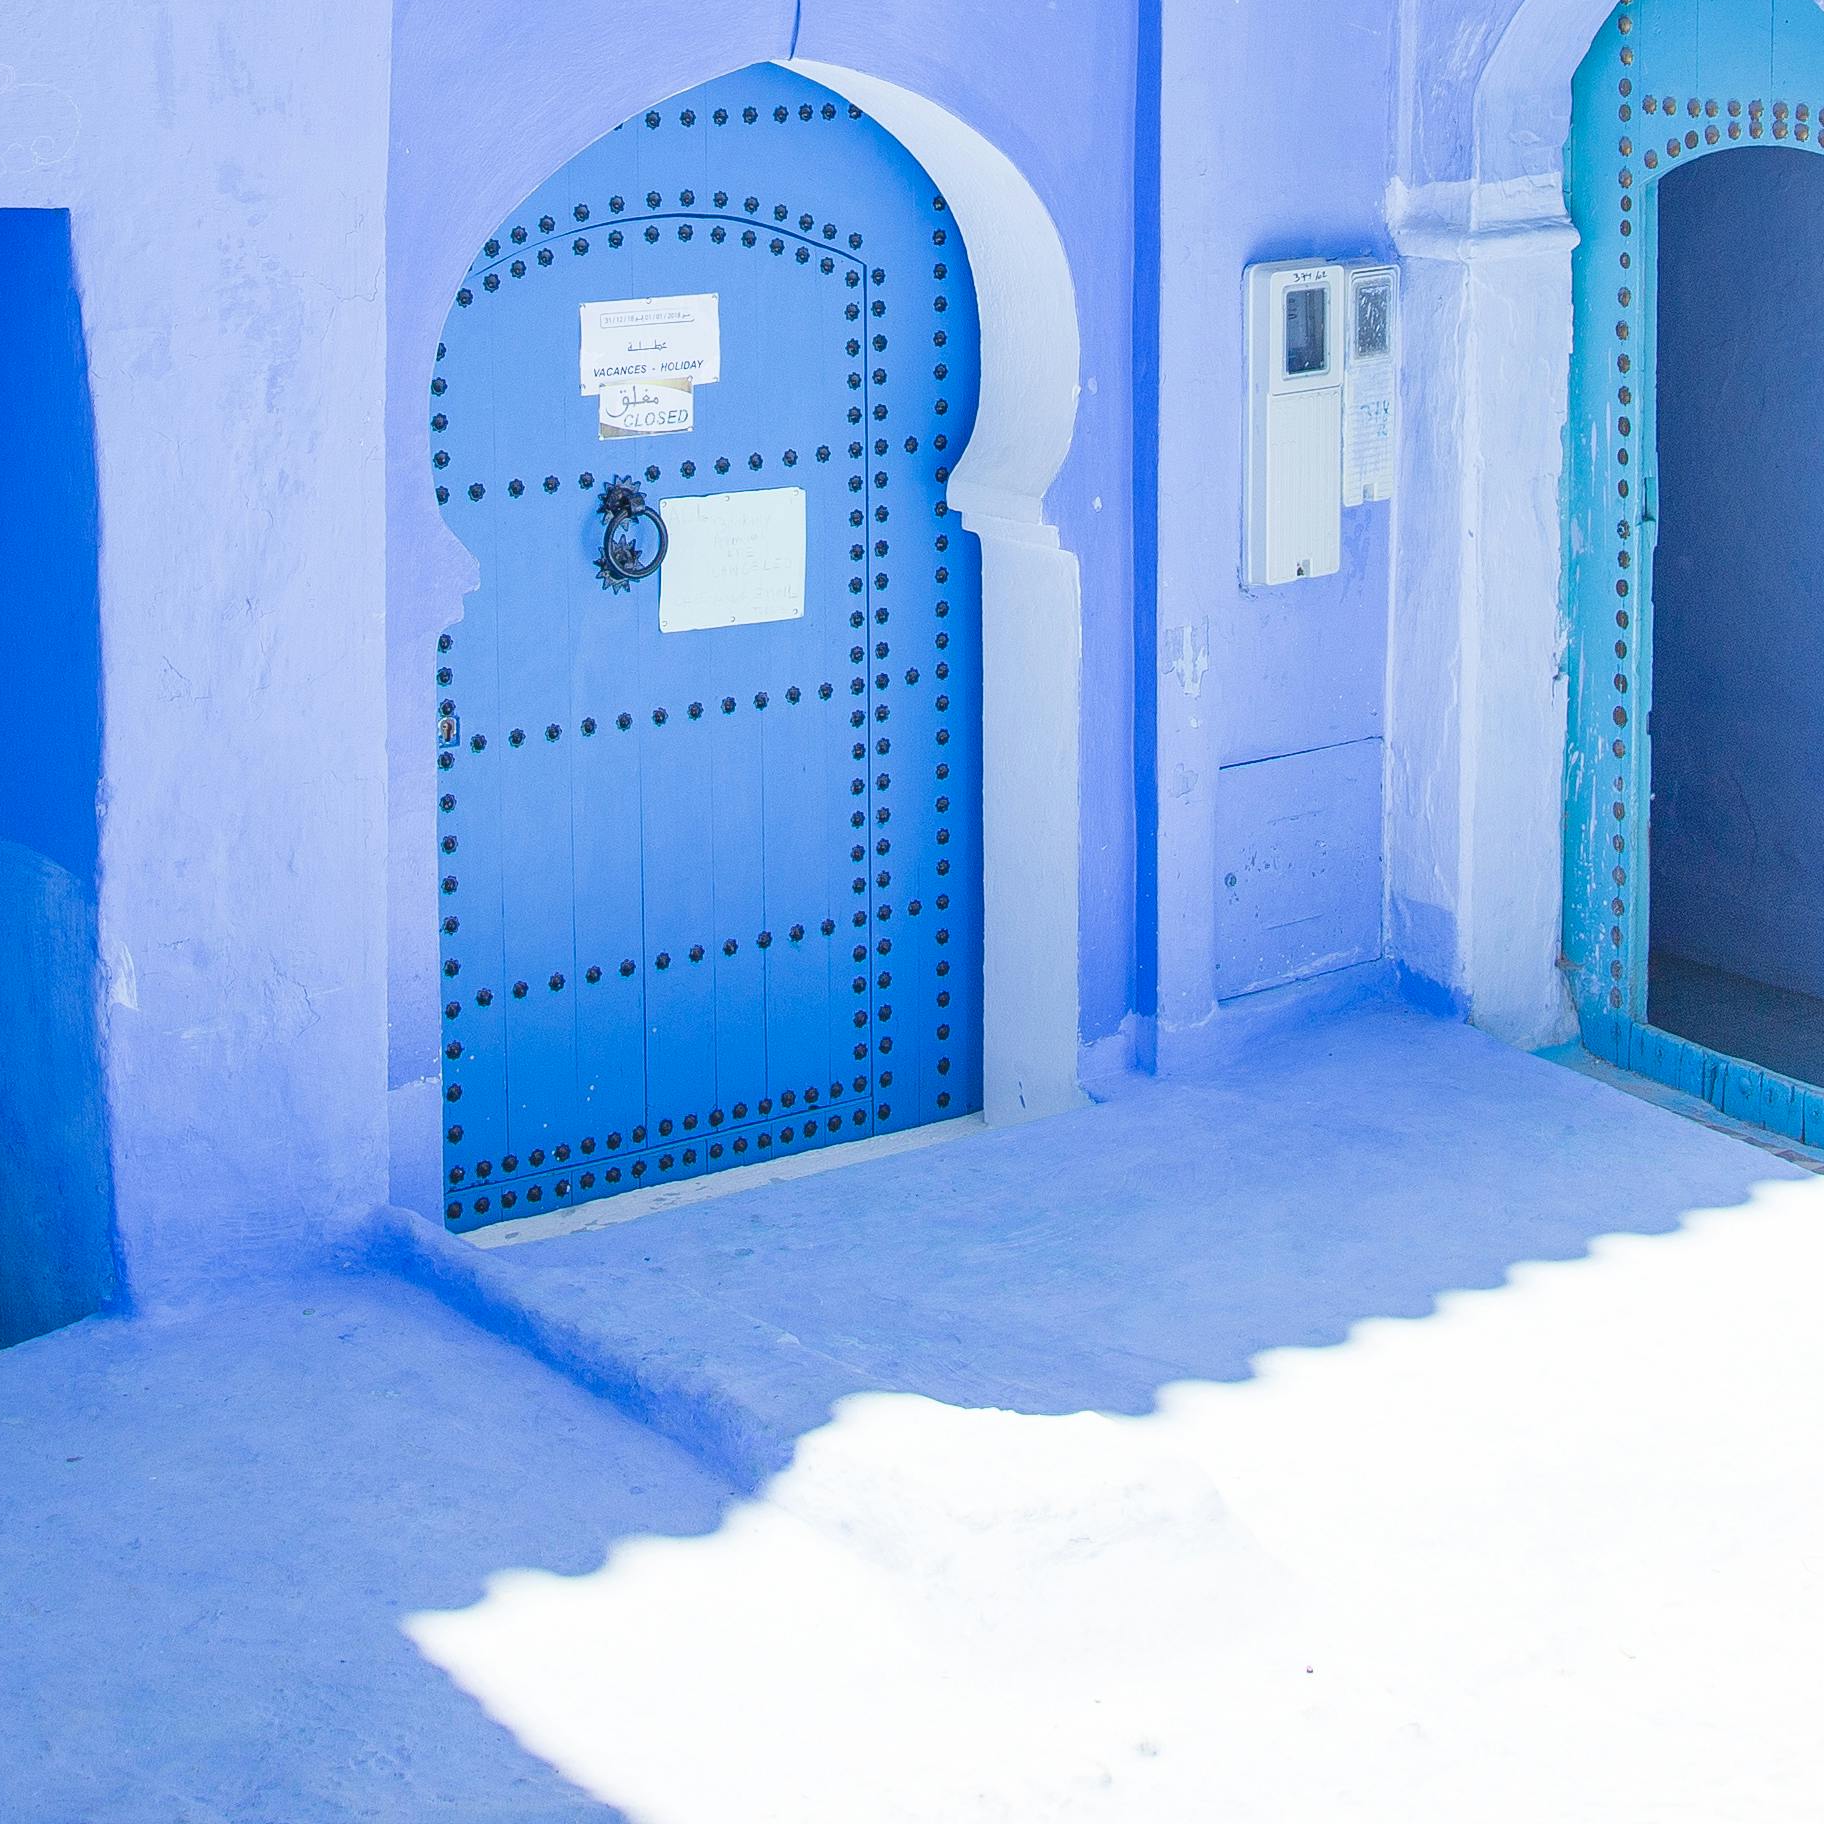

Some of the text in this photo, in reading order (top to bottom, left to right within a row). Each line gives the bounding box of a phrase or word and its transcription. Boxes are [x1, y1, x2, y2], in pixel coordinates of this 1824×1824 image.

[593, 364, 647, 377] VACANCES
[660, 360, 704, 373] HOLIDAY
[606, 385, 659, 418] مغلق
[623, 409, 689, 428] CLOSED
